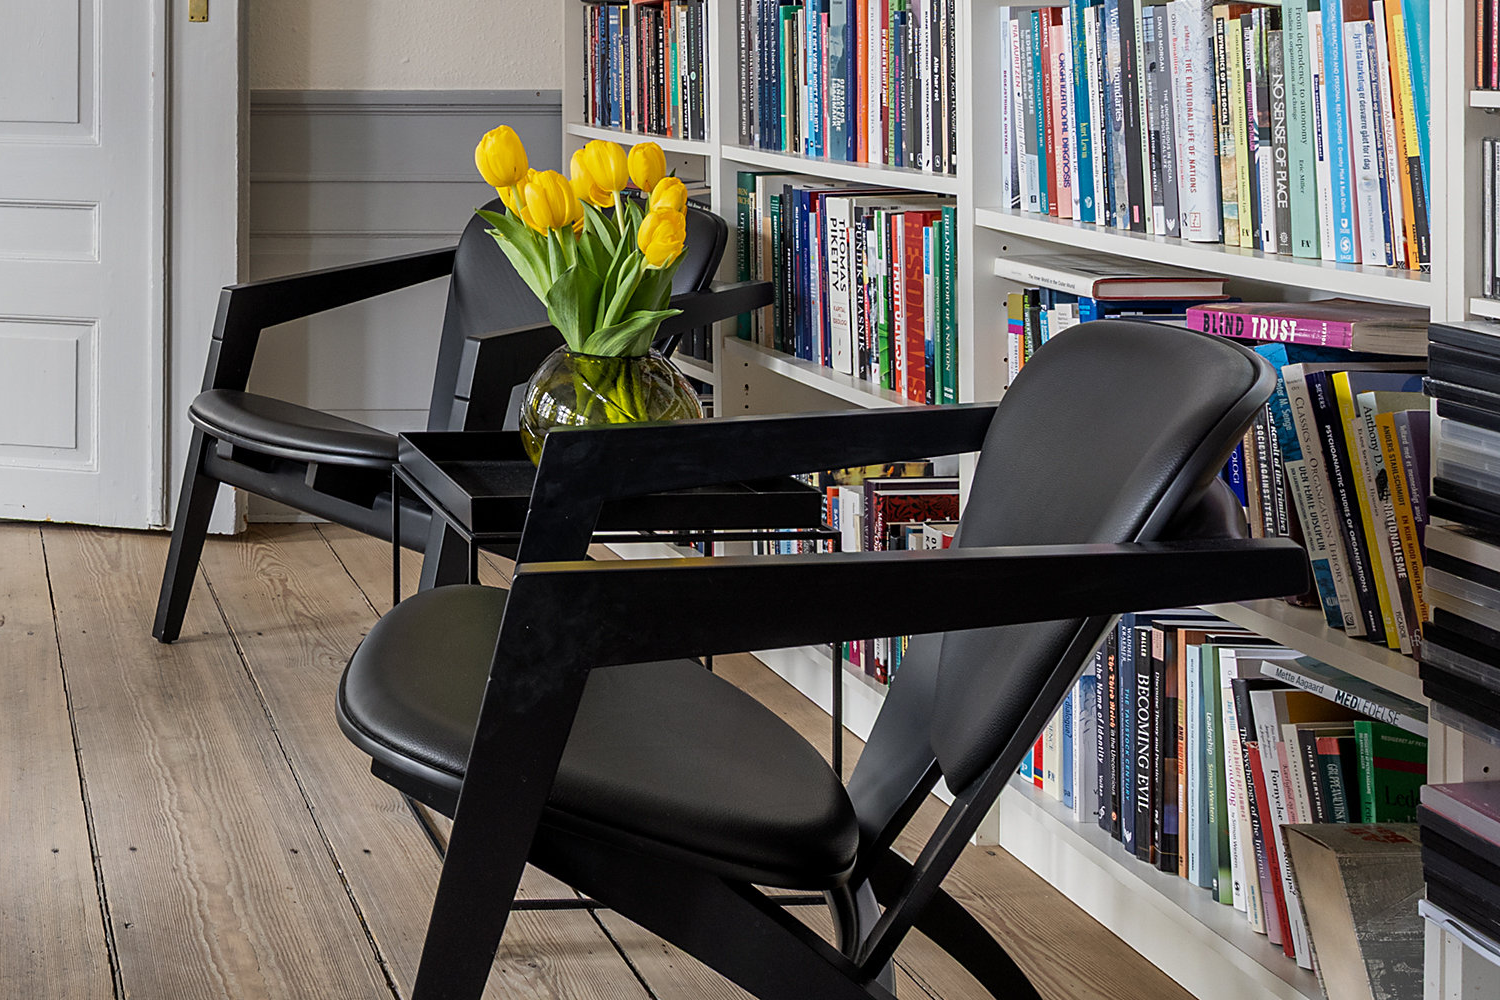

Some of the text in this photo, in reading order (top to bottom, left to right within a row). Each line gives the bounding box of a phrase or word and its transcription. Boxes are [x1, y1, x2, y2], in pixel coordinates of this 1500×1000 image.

[1295, 7, 1303, 29] From
[1013, 40, 1021, 88] LAURITZEN
[1217, 35, 1225, 70] DYNAMICS
[1296, 32, 1306, 86] dependency
[1273, 75, 1288, 208] NO SENSE OF PLACE
[1299, 100, 1308, 145] autonomy
[830, 218, 839, 291] PIKETTY
[839, 219, 847, 292] THOMAS
[855, 222, 864, 351] PUNDIK KRASNIK
[1203, 313, 1297, 342] BLIND TRUST
[1363, 406, 1383, 466] Anthony D.
[1256, 424, 1273, 533] SOCIETY AGAINST ITSELF
[1384, 504, 1406, 578] NATIONALISME
[1275, 667, 1325, 694] Mette Aagaard
[1205, 712, 1214, 755] Leadership
[1334, 690, 1400, 726] MEDLEDELSE
[1137, 673, 1150, 813] BECOMING EVIL
